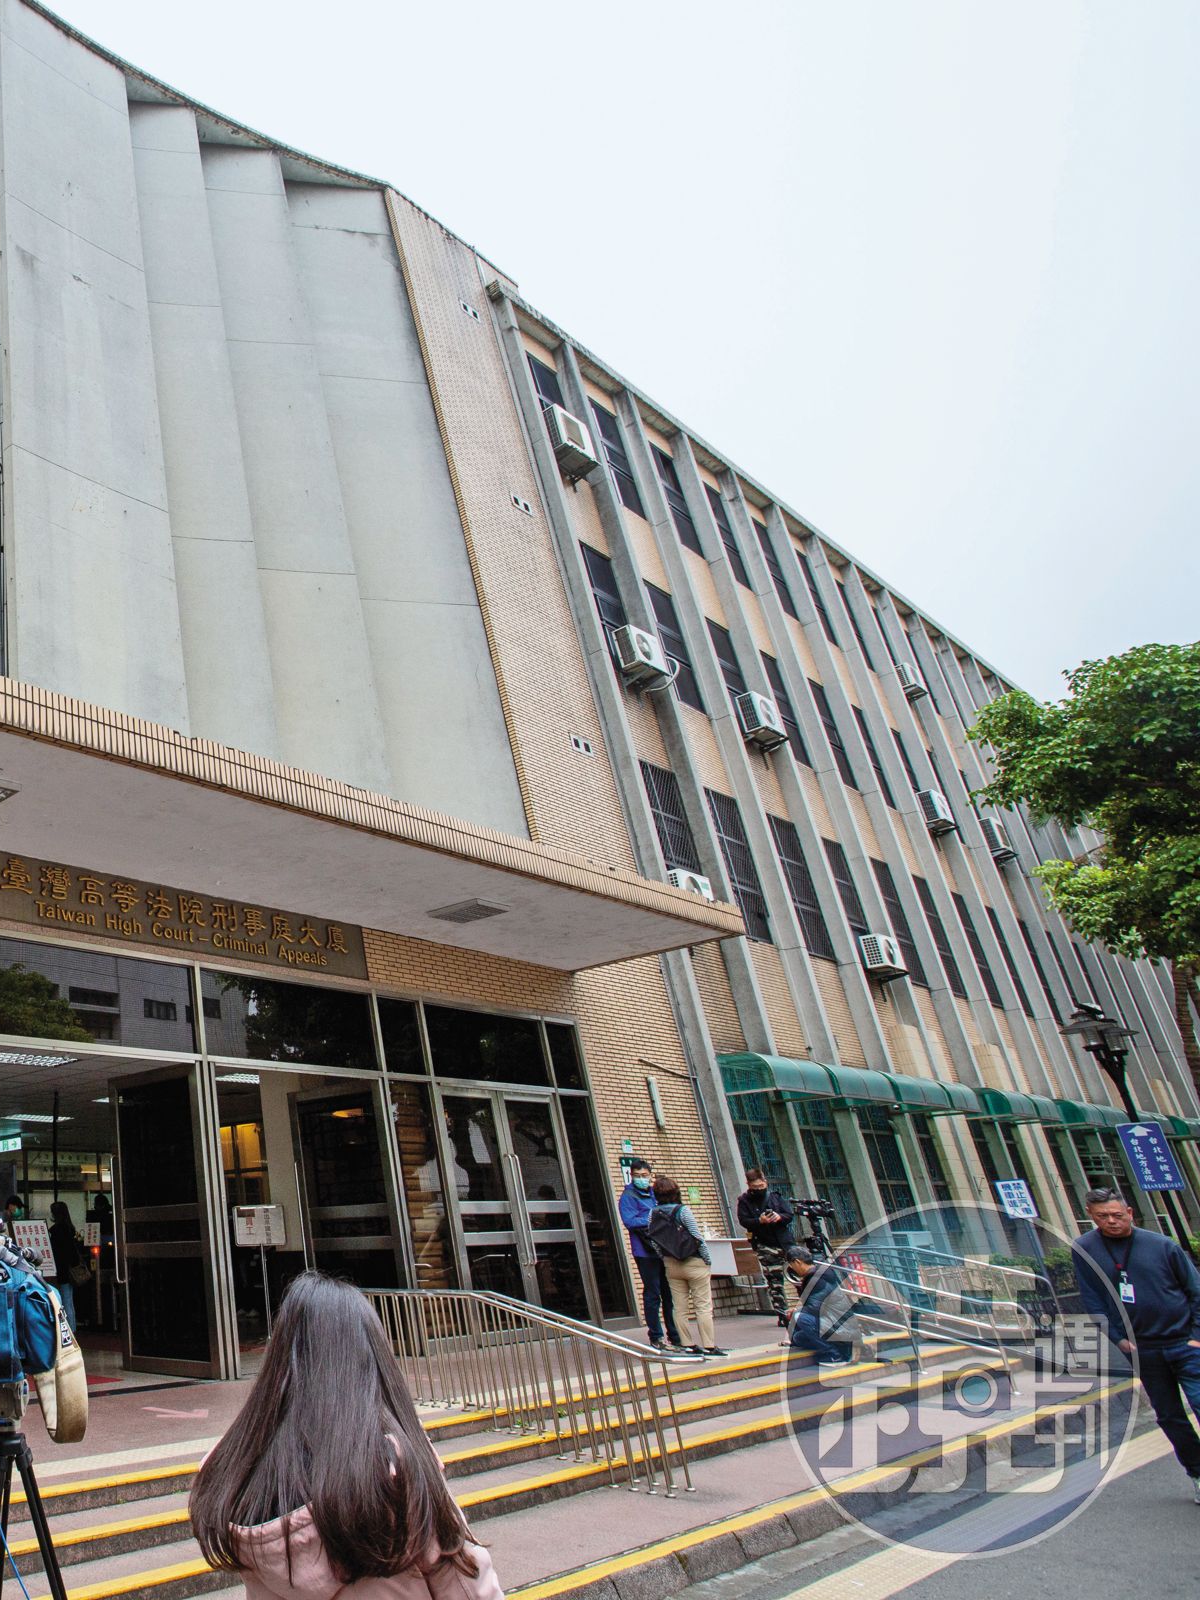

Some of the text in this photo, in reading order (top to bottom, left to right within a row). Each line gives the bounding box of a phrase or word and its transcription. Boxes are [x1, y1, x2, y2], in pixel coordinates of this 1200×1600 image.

[0, 857, 349, 954] 臺灣高等法院刑事庭大廈
[36, 901, 95, 926] Taiwan
[106, 913, 142, 935] High
[153, 922, 195, 943] Court
[212, 933, 269, 956] Criminal
[278, 944, 328, 967] Appeals
